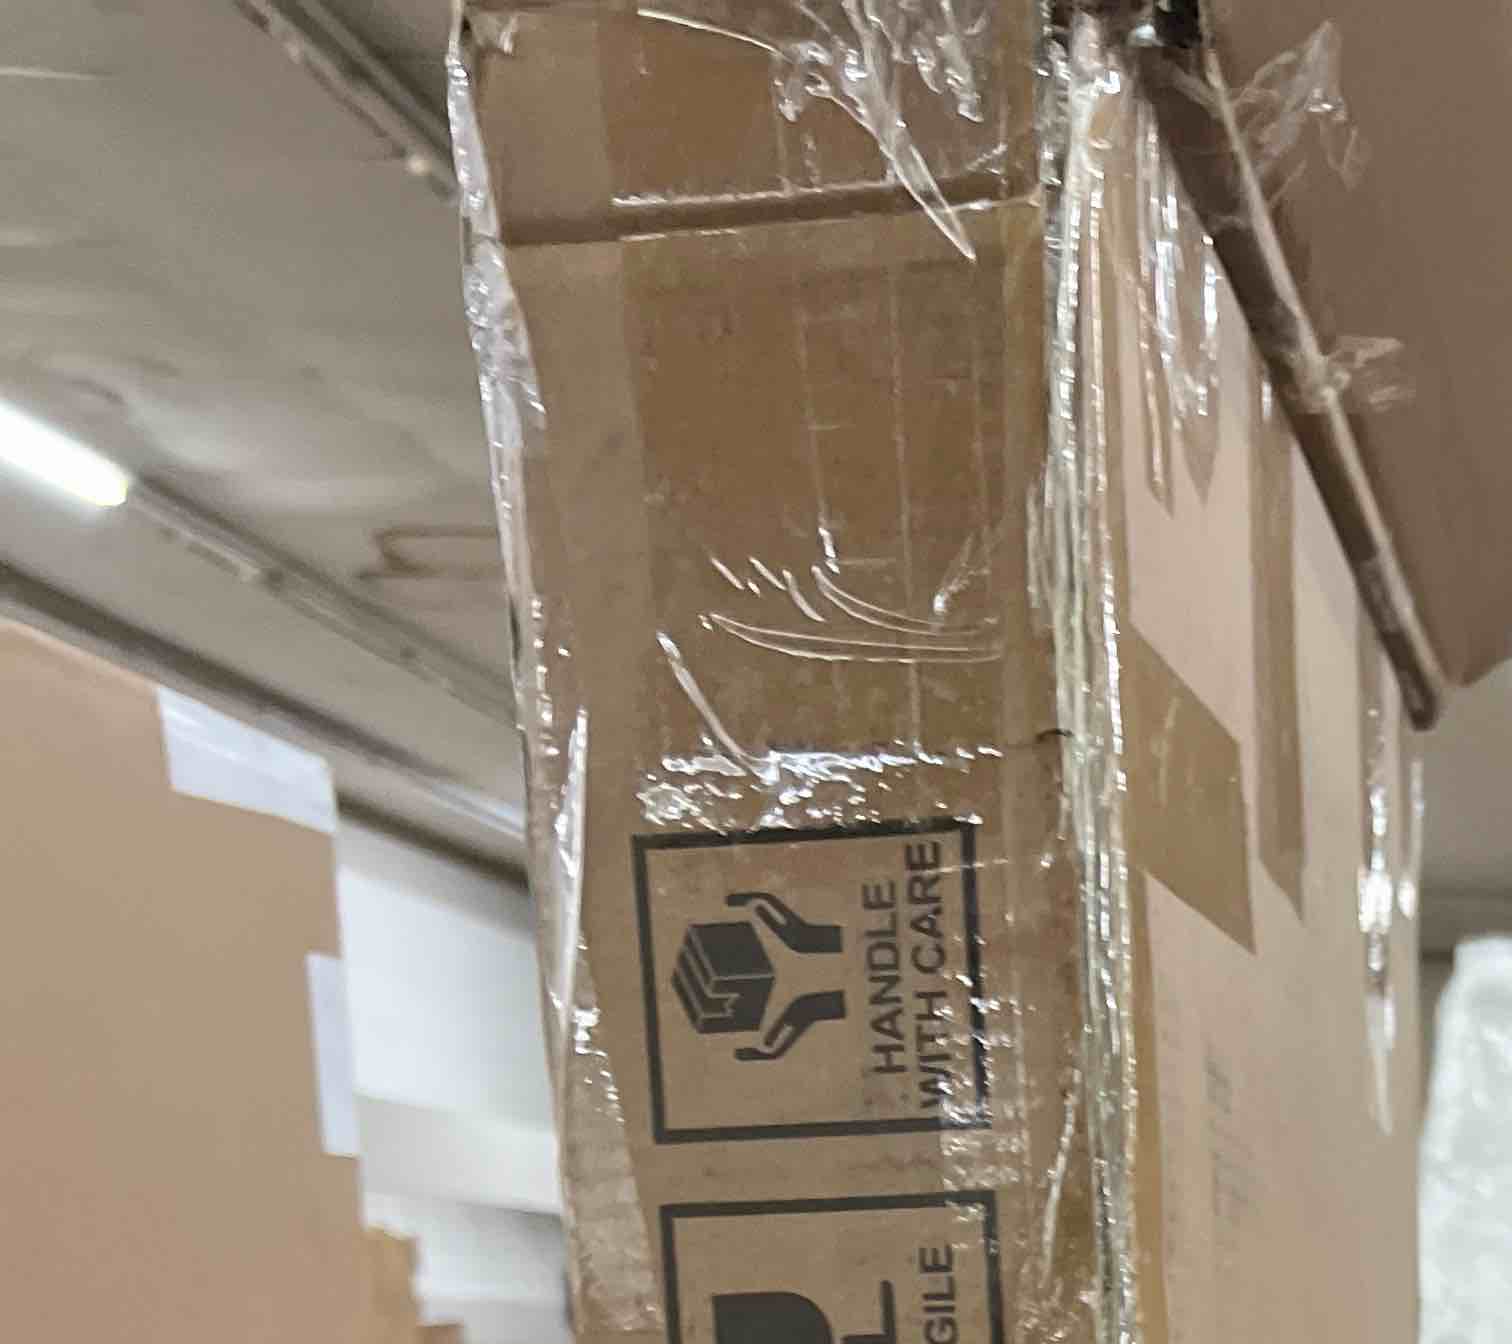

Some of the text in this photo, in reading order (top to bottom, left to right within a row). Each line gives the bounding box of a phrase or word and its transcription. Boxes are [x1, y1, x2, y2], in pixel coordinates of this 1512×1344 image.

[862, 879, 907, 1075] HANDLE
[905, 840, 956, 1108] WITH CARE
